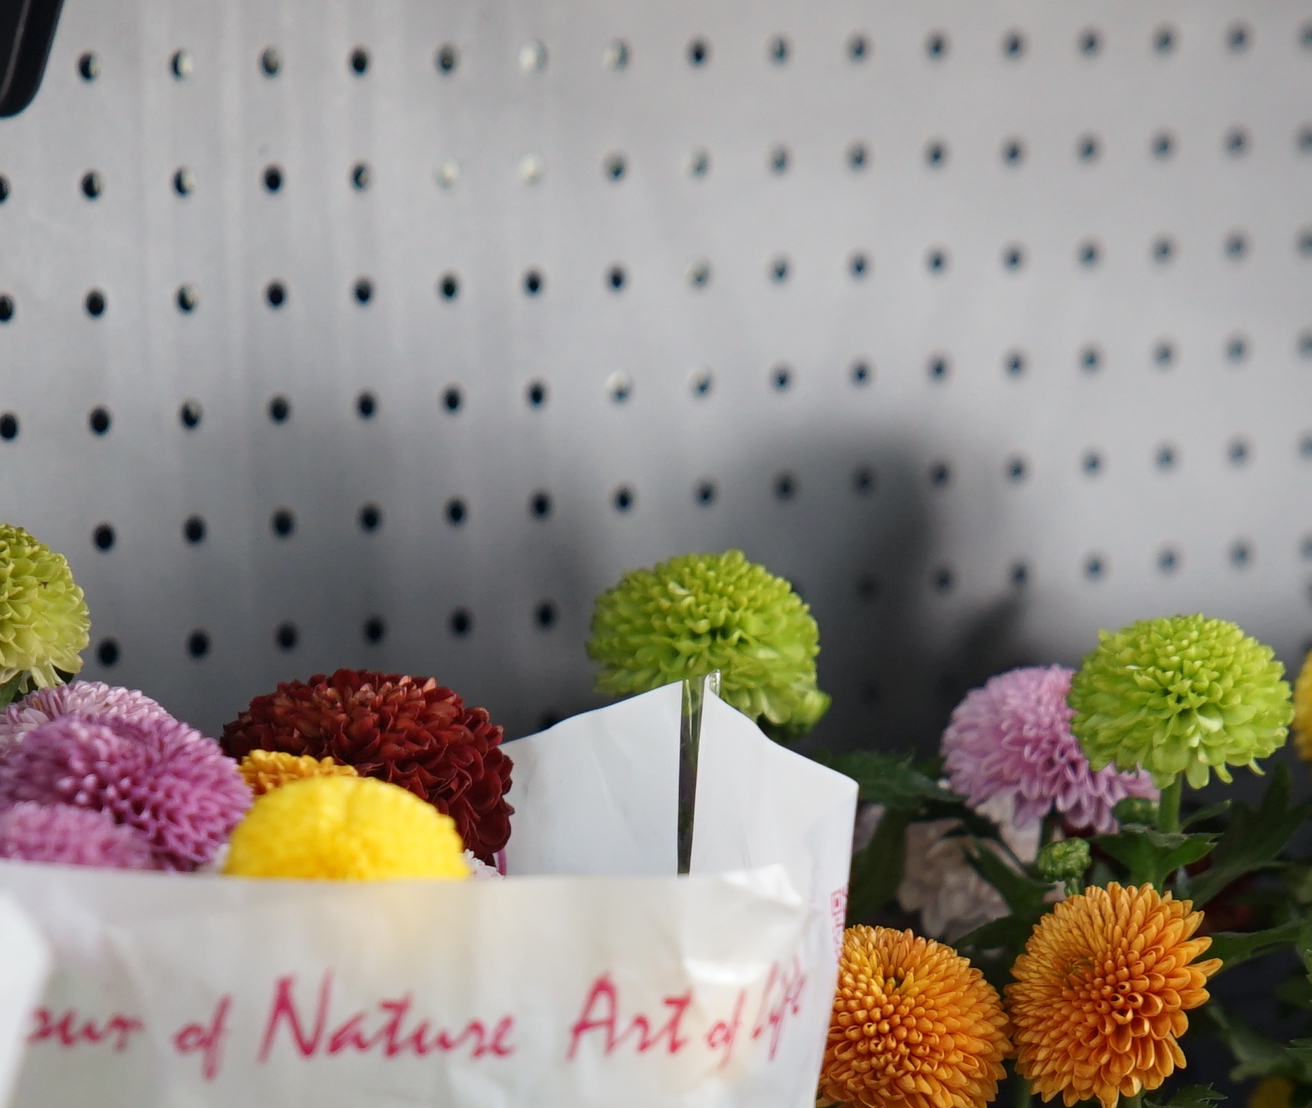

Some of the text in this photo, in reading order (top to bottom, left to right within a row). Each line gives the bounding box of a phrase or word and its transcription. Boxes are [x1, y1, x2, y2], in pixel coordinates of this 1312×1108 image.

[171, 993, 233, 1081] of
[259, 966, 518, 1063] Nature
[566, 968, 696, 1062] Art
[706, 986, 747, 1072] of
